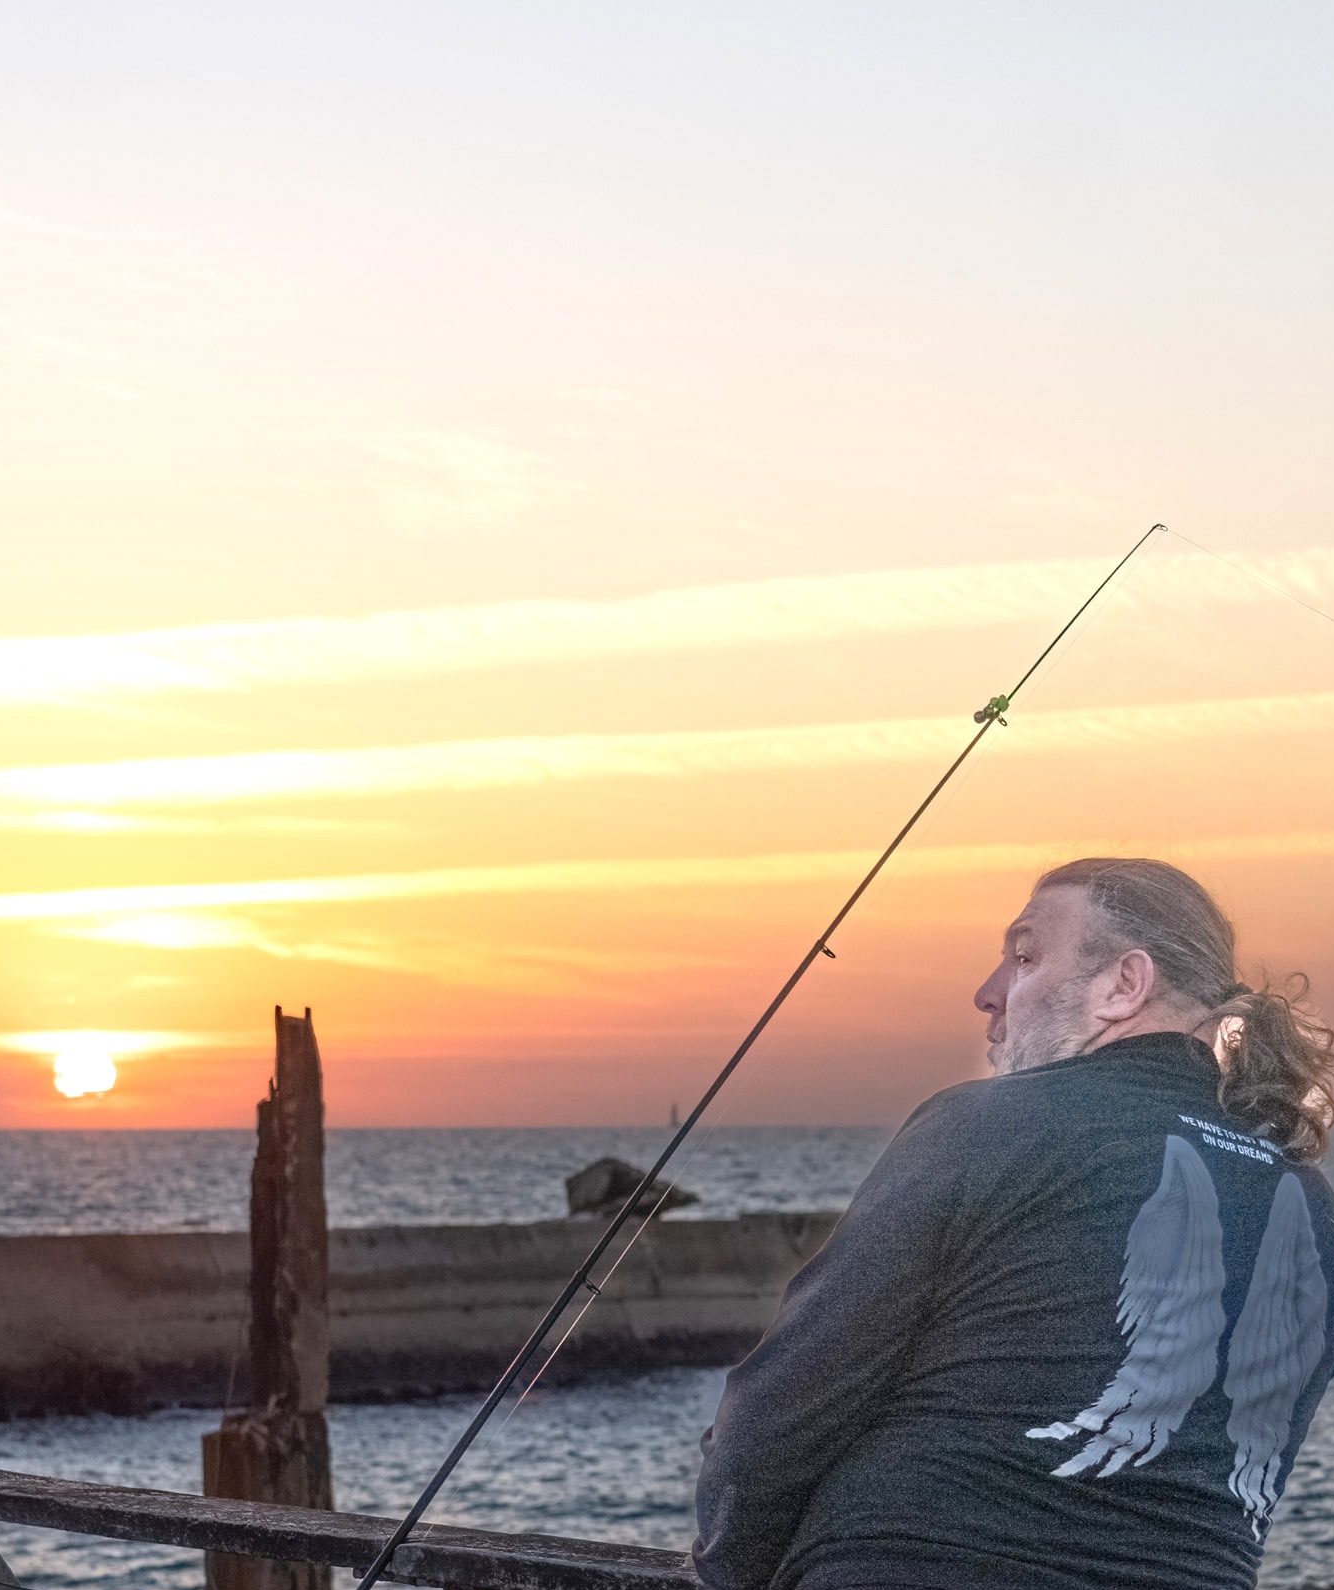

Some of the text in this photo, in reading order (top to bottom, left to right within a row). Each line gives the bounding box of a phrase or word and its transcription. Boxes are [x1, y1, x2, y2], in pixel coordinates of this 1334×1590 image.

[1178, 1114, 1197, 1126] WE
[1196, 1119, 1223, 1136] HAVE
[1222, 1129, 1236, 1140] TO
[1236, 1134, 1256, 1144] PUT
[1202, 1133, 1274, 1165] ON OUR DREAMS
